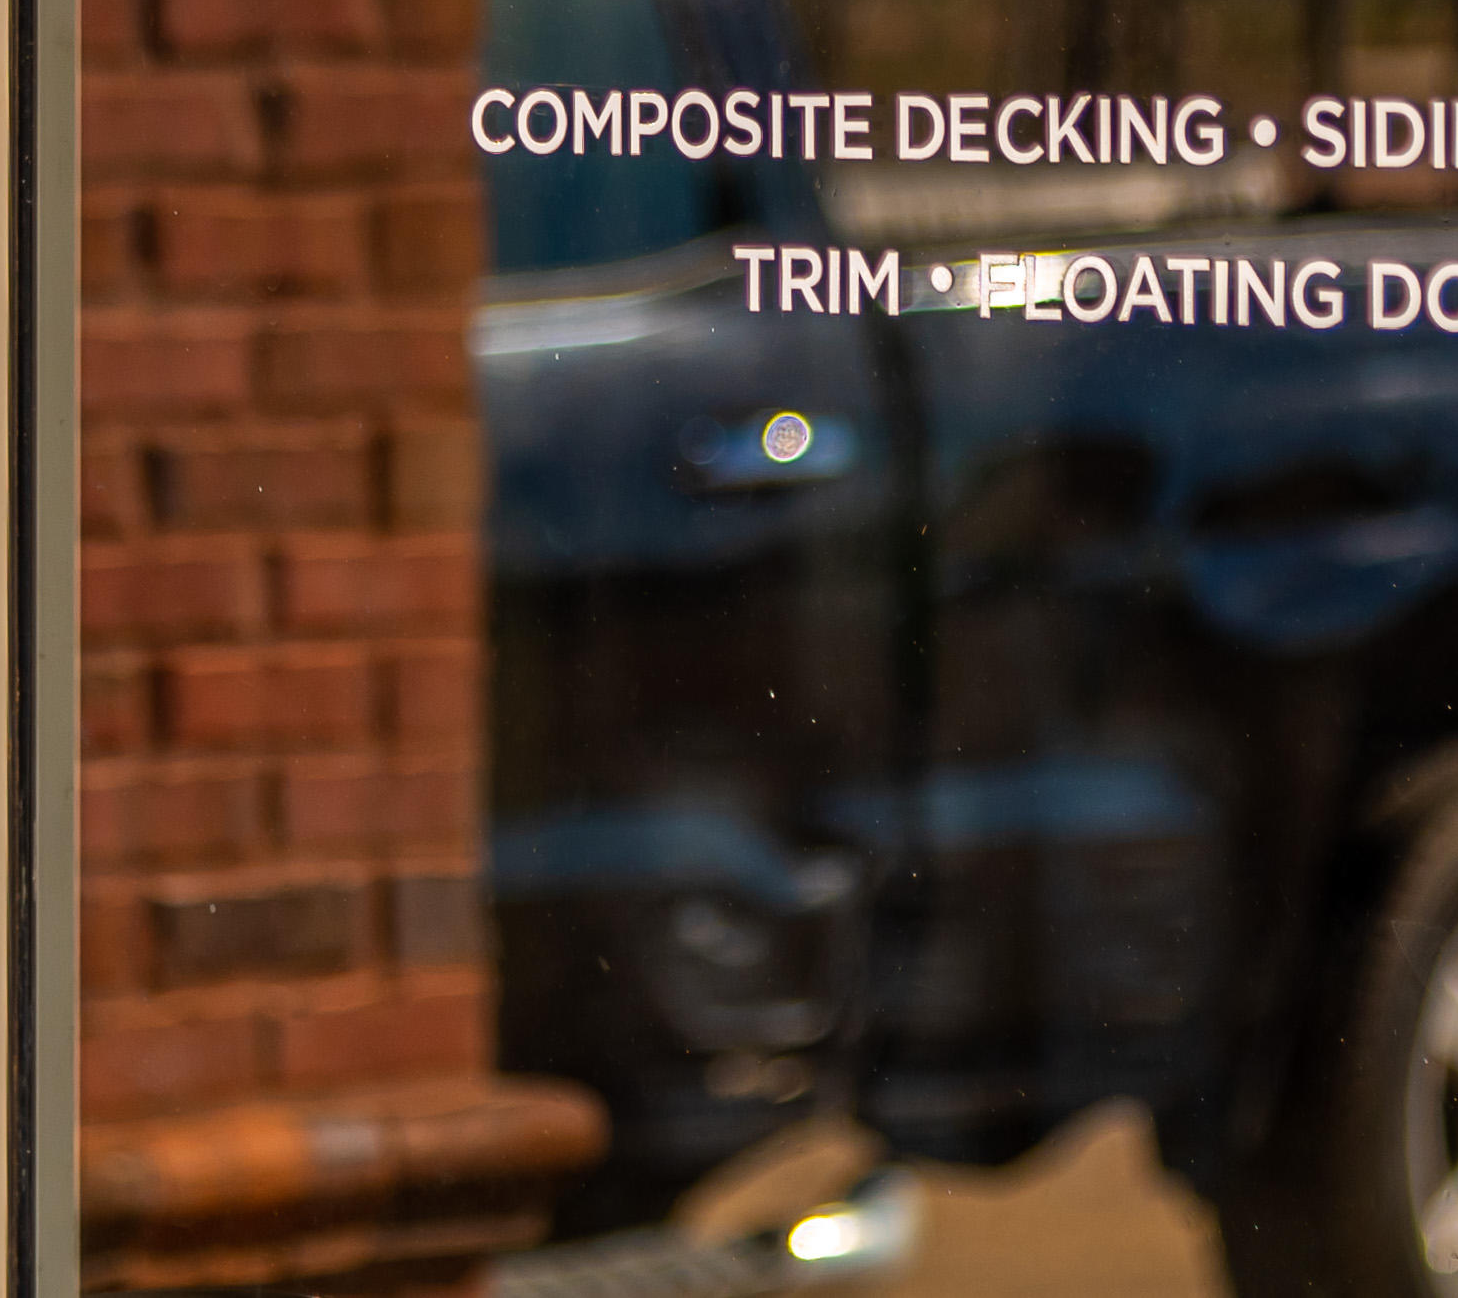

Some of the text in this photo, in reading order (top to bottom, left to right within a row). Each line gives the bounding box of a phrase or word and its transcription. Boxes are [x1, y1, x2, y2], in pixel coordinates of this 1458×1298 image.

[469, 87, 872, 162] COMPOSITE
[895, 91, 1226, 171] DECKING
[734, 246, 901, 317] TRIM
[980, 252, 1345, 333] FLOATING
